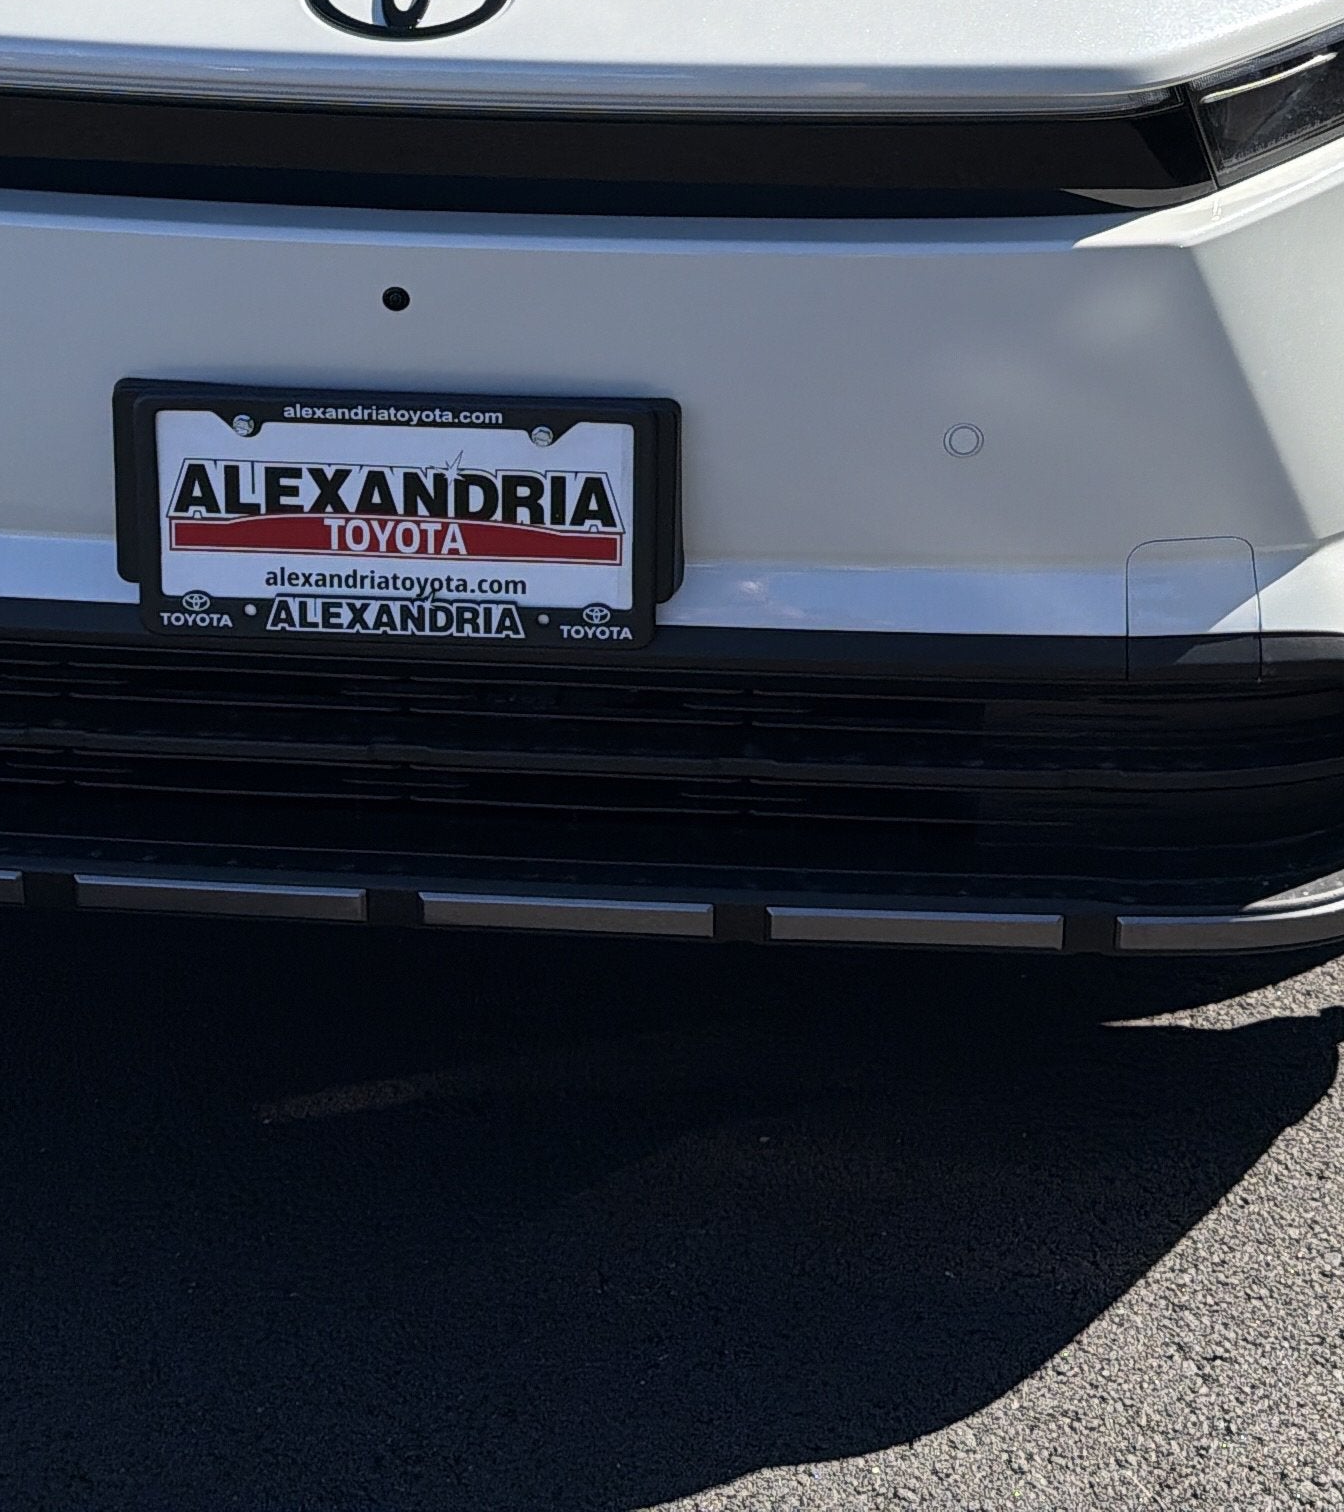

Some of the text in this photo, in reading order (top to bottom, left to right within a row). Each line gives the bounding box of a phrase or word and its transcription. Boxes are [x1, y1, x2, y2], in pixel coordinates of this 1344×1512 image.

[282, 403, 504, 425] alexandriatoyota.com
[170, 460, 623, 532] ALEXANDRIA
[324, 517, 468, 556] TOYOTA
[264, 566, 528, 596] alexandriatoyota.com
[159, 610, 233, 629] TOYOTA
[266, 595, 524, 639] ALEXANDRIA
[559, 623, 633, 642] TOYOTA
